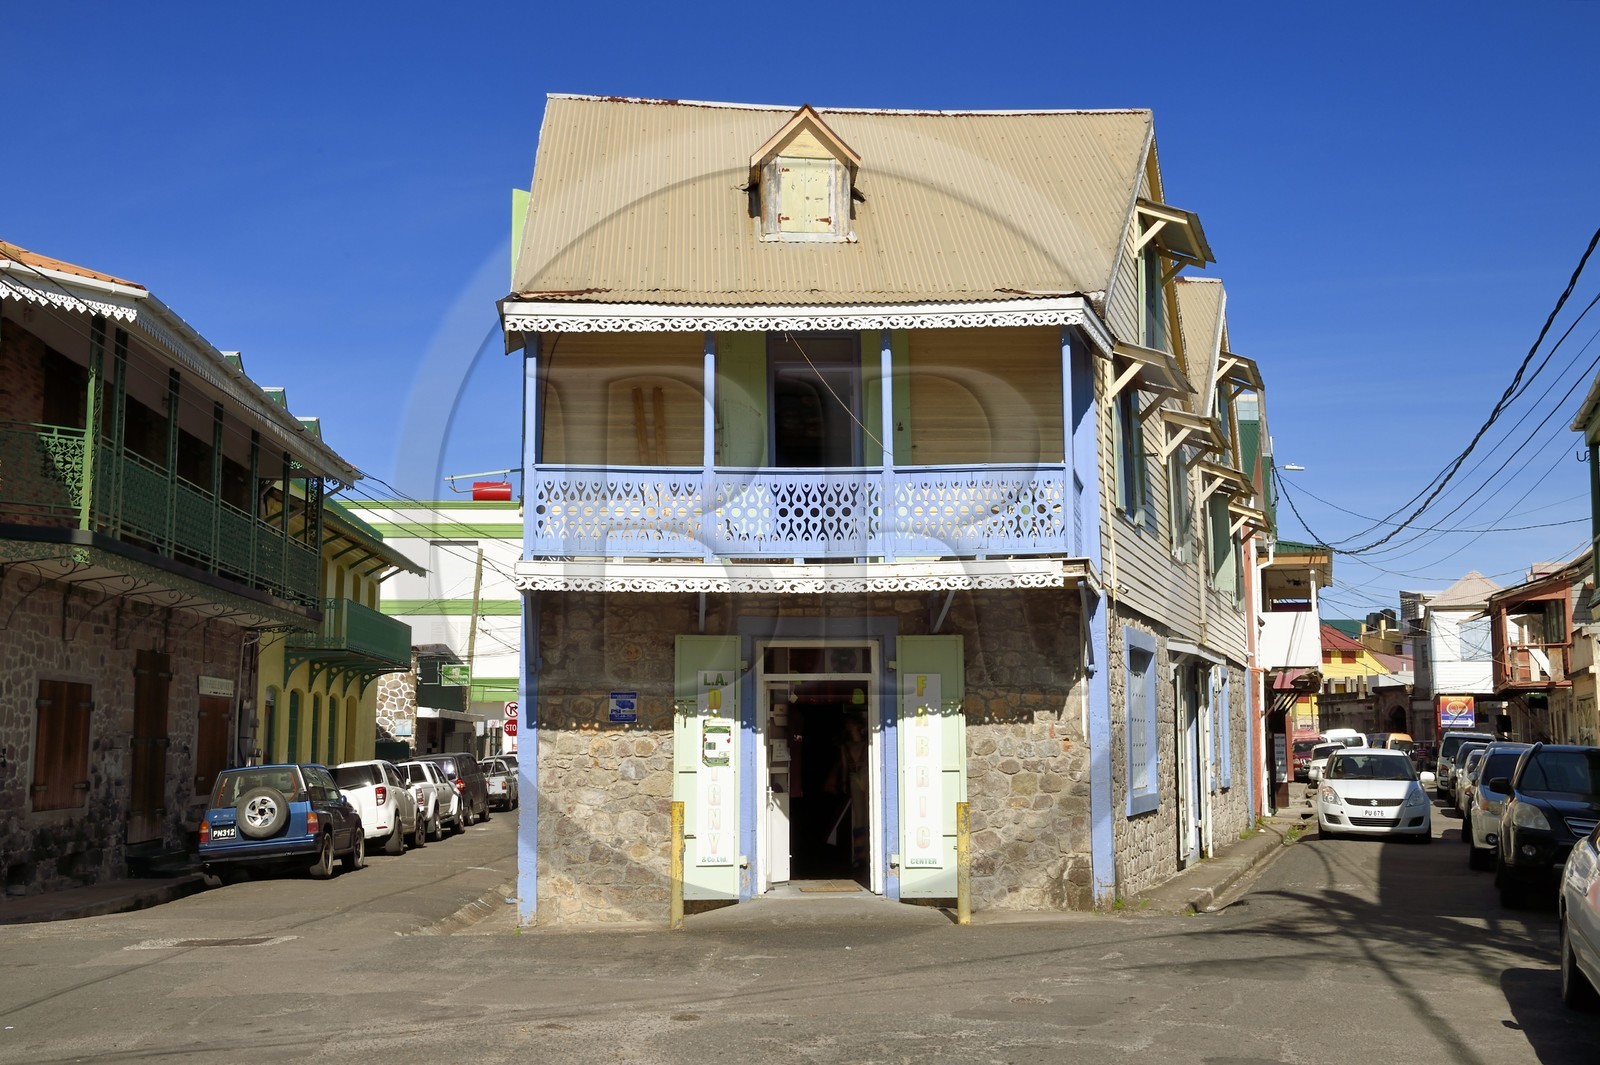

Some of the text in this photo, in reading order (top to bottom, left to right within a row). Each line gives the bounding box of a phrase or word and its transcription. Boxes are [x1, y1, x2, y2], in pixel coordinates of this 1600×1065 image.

[703, 672, 728, 686] L.A.
[505, 724, 517, 732] STO
[915, 675, 930, 849] FABRIC
[707, 688, 721, 854] DIGNY
[212, 828, 235, 838] PN312
[910, 857, 937, 865] CENTER
